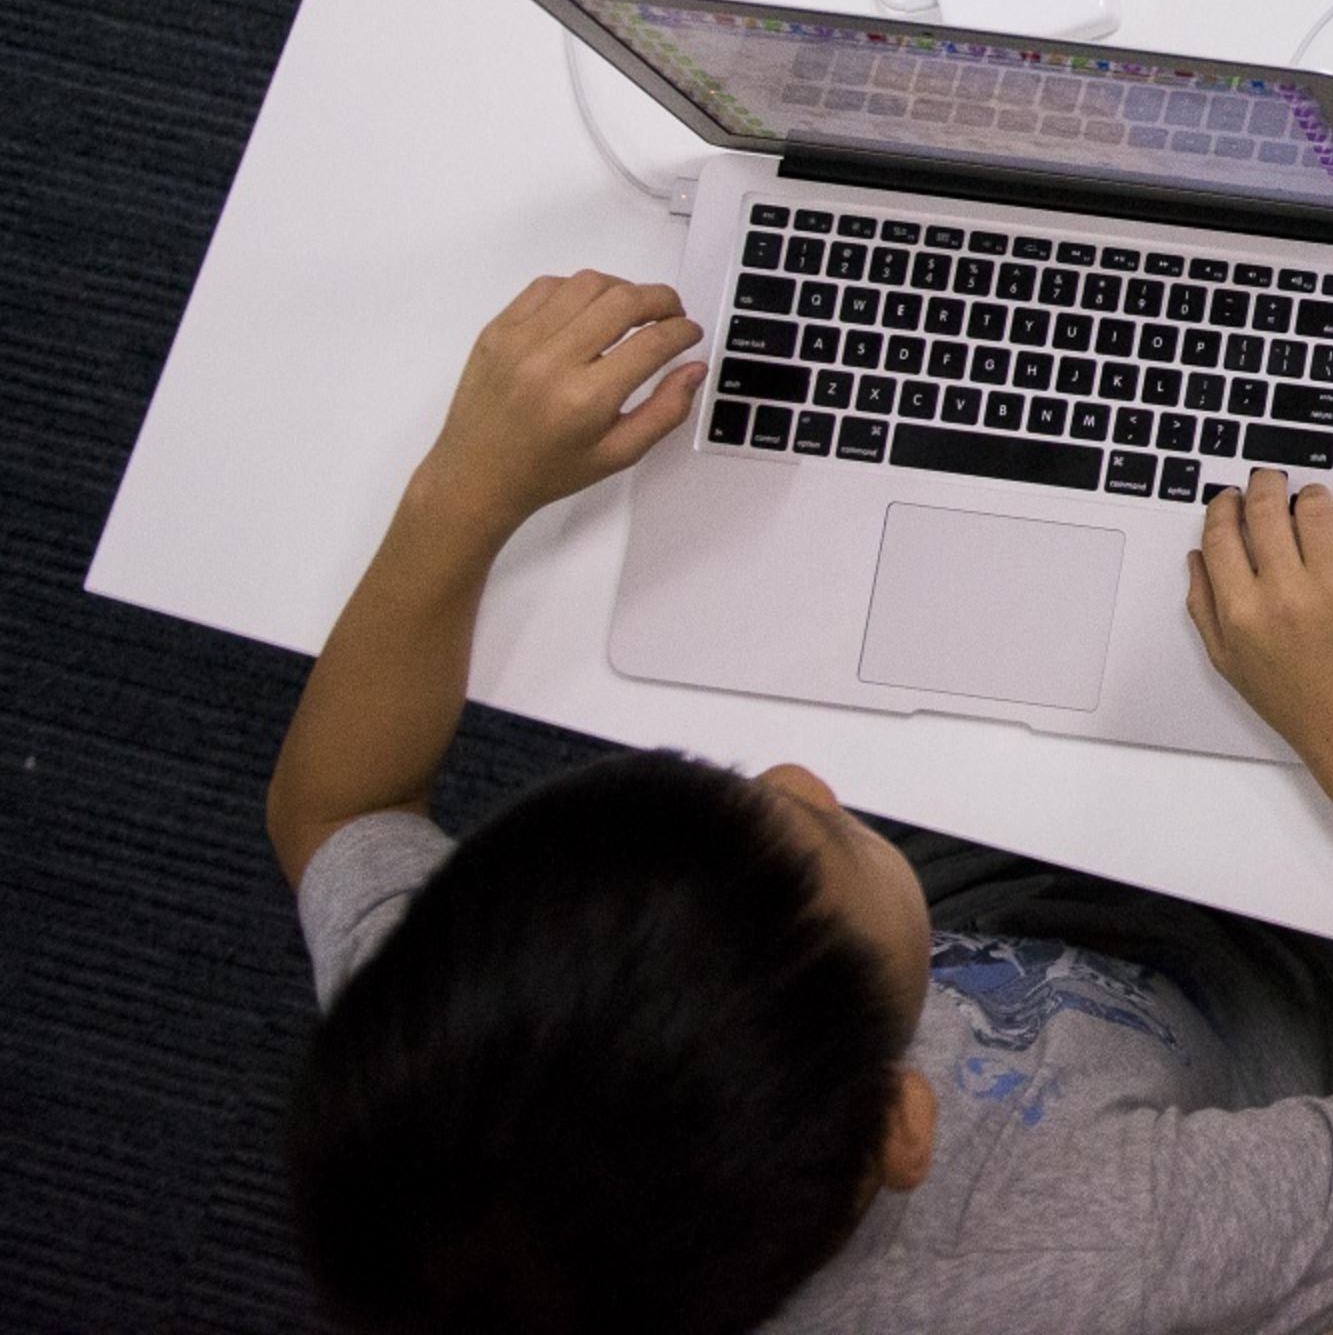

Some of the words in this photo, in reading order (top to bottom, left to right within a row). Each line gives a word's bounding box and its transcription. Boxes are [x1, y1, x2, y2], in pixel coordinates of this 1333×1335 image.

[800, 256, 805, 268] 1
[840, 262, 849, 273] 2
[883, 267, 890, 278] 3
[925, 272, 933, 283] 4
[967, 277, 975, 288] 5
[1009, 283, 1017, 294] 6
[1053, 288, 1061, 298] 7
[1095, 294, 1103, 304] 8
[1138, 298, 1146, 309] 9
[1181, 304, 1189, 315] 0
[811, 294, 822, 306] Q
[853, 299, 866, 311] W
[897, 304, 905, 316] E
[939, 309, 948, 321] R
[984, 314, 990, 326] T
[1025, 320, 1034, 331] Y
[1067, 326, 1077, 338] U
[1112, 331, 1117, 342] I
[1152, 336, 1163, 348] O
[1196, 341, 1205, 352] P
[813, 337, 823, 349] A
[857, 343, 865, 355] S
[899, 348, 909, 360] D
[943, 353, 951, 365] F
[984, 359, 995, 371] G
[1027, 365, 1037, 376] H
[1071, 370, 1079, 382] J
[1113, 375, 1122, 387] K
[1157, 381, 1164, 392] L
[827, 382, 837, 395] Z
[870, 388, 880, 400] X
[913, 394, 923, 406] C
[956, 399, 965, 410] V
[999, 404, 1007, 416] B
[1041, 410, 1052, 422] N
[1083, 415, 1095, 427] M
